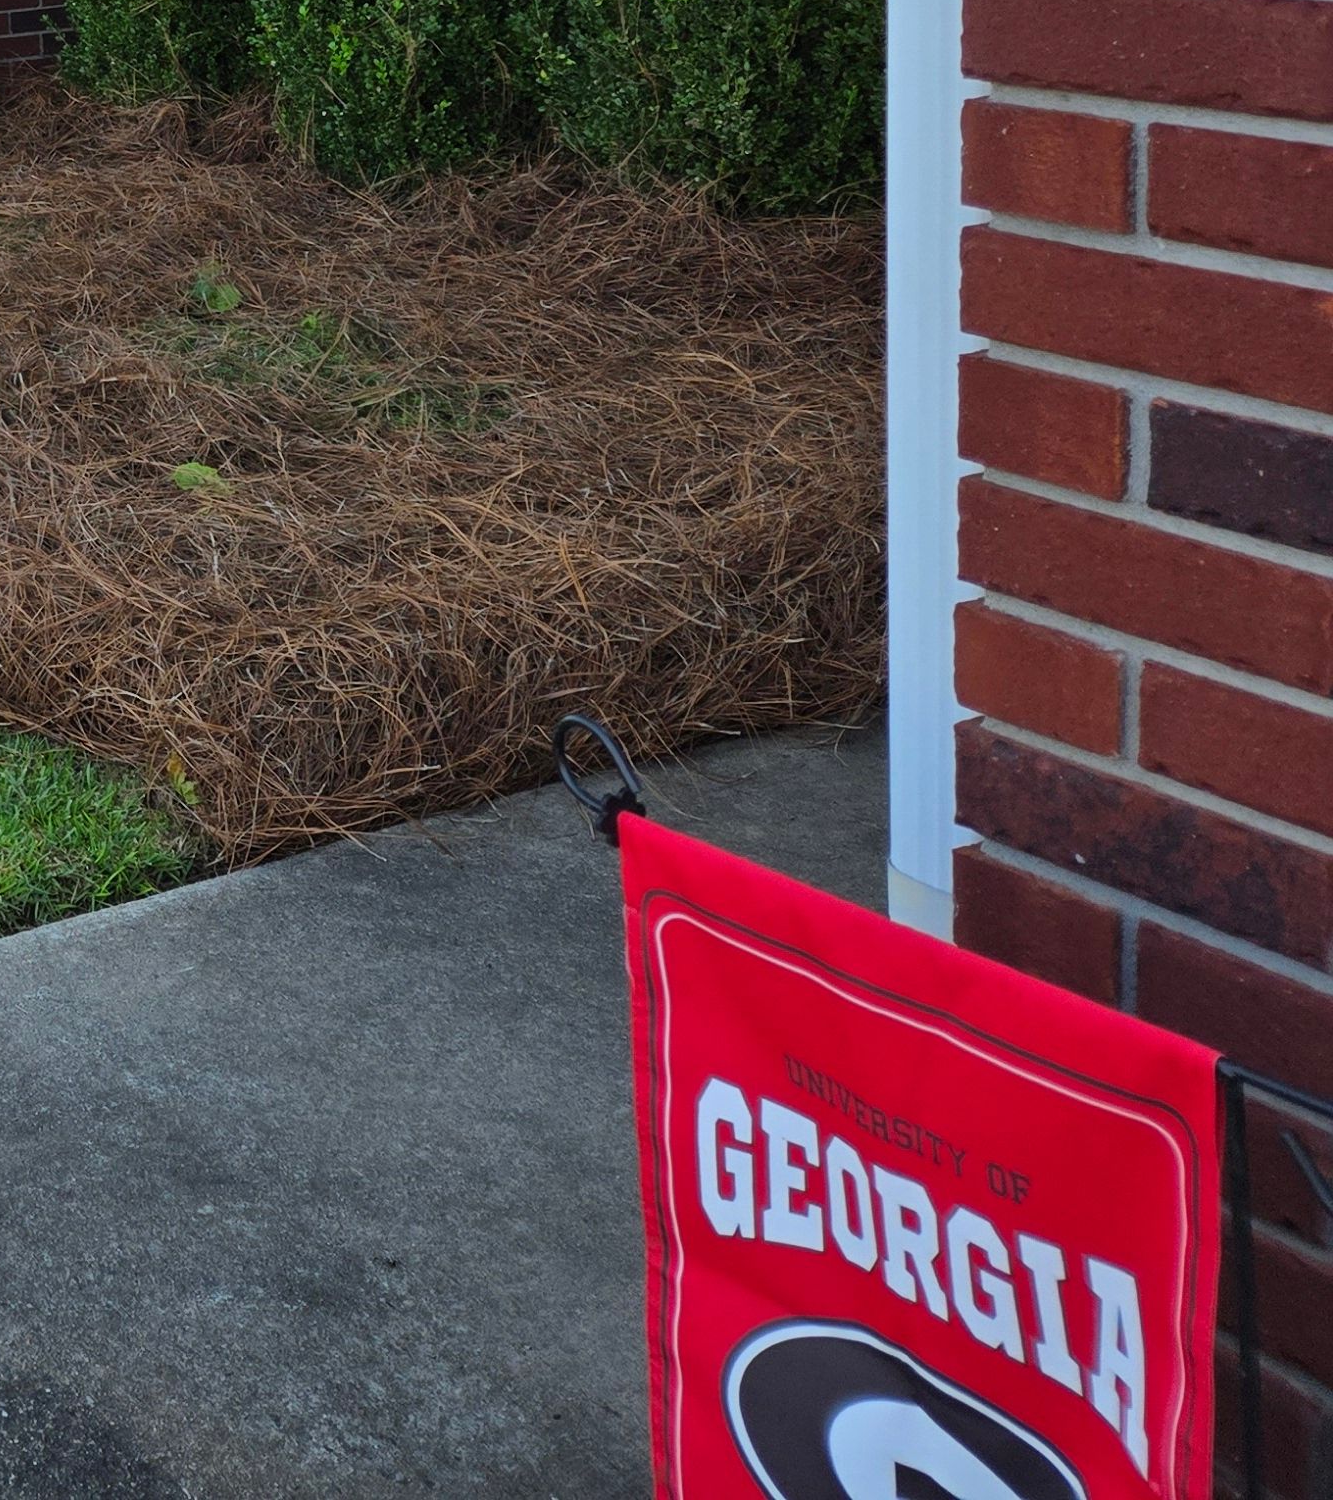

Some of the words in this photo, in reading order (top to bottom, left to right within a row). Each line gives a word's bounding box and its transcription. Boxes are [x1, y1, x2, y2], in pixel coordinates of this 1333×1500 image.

[784, 1053, 967, 1177] UNIVERSITY
[986, 1161, 1030, 1204] OF
[695, 1075, 1150, 1482] GEORGIA
